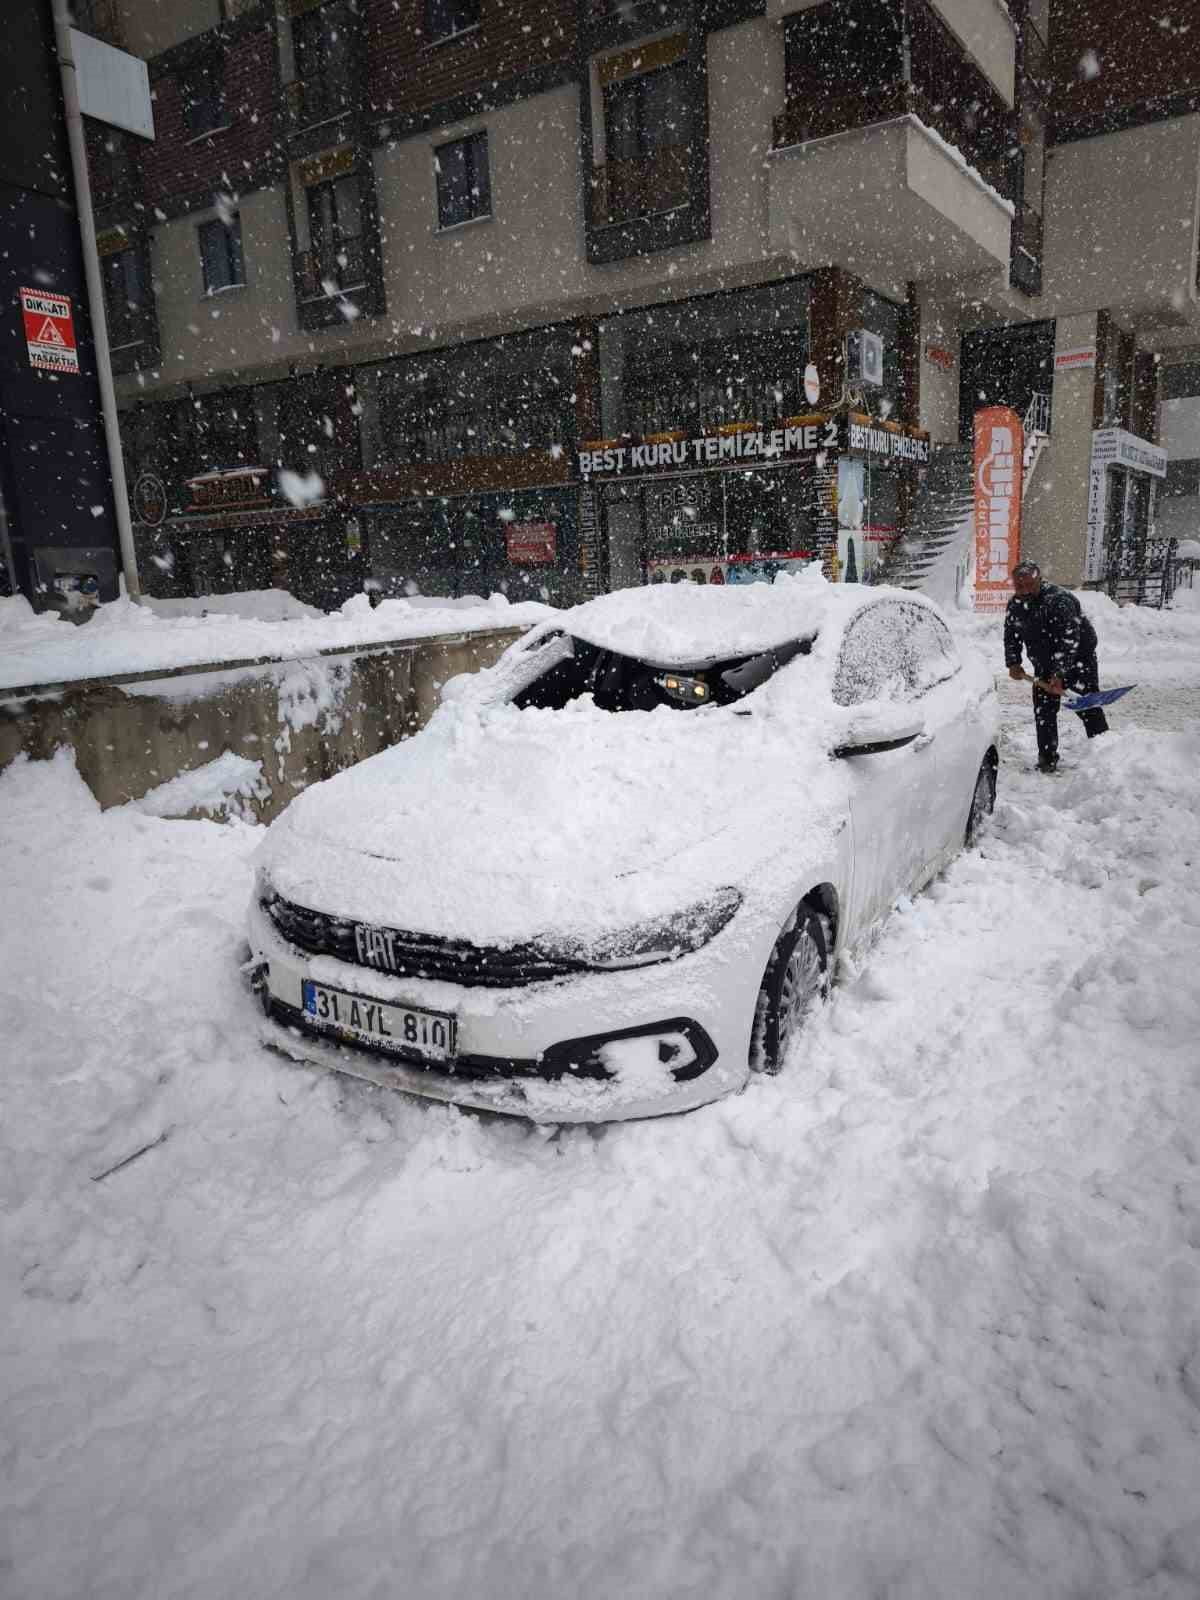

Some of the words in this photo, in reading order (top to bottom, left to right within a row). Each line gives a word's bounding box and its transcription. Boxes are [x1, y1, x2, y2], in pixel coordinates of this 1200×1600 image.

[578, 448, 626, 472] BEST
[631, 440, 687, 467] KURU
[822, 422, 839, 447] 2
[850, 424, 869, 448] BEST
[869, 428, 889, 453] KURU
[355, 923, 397, 970] FIAT
[318, 990, 339, 1021] 31
[350, 1000, 392, 1036] AYL
[403, 1013, 446, 1048] 810
